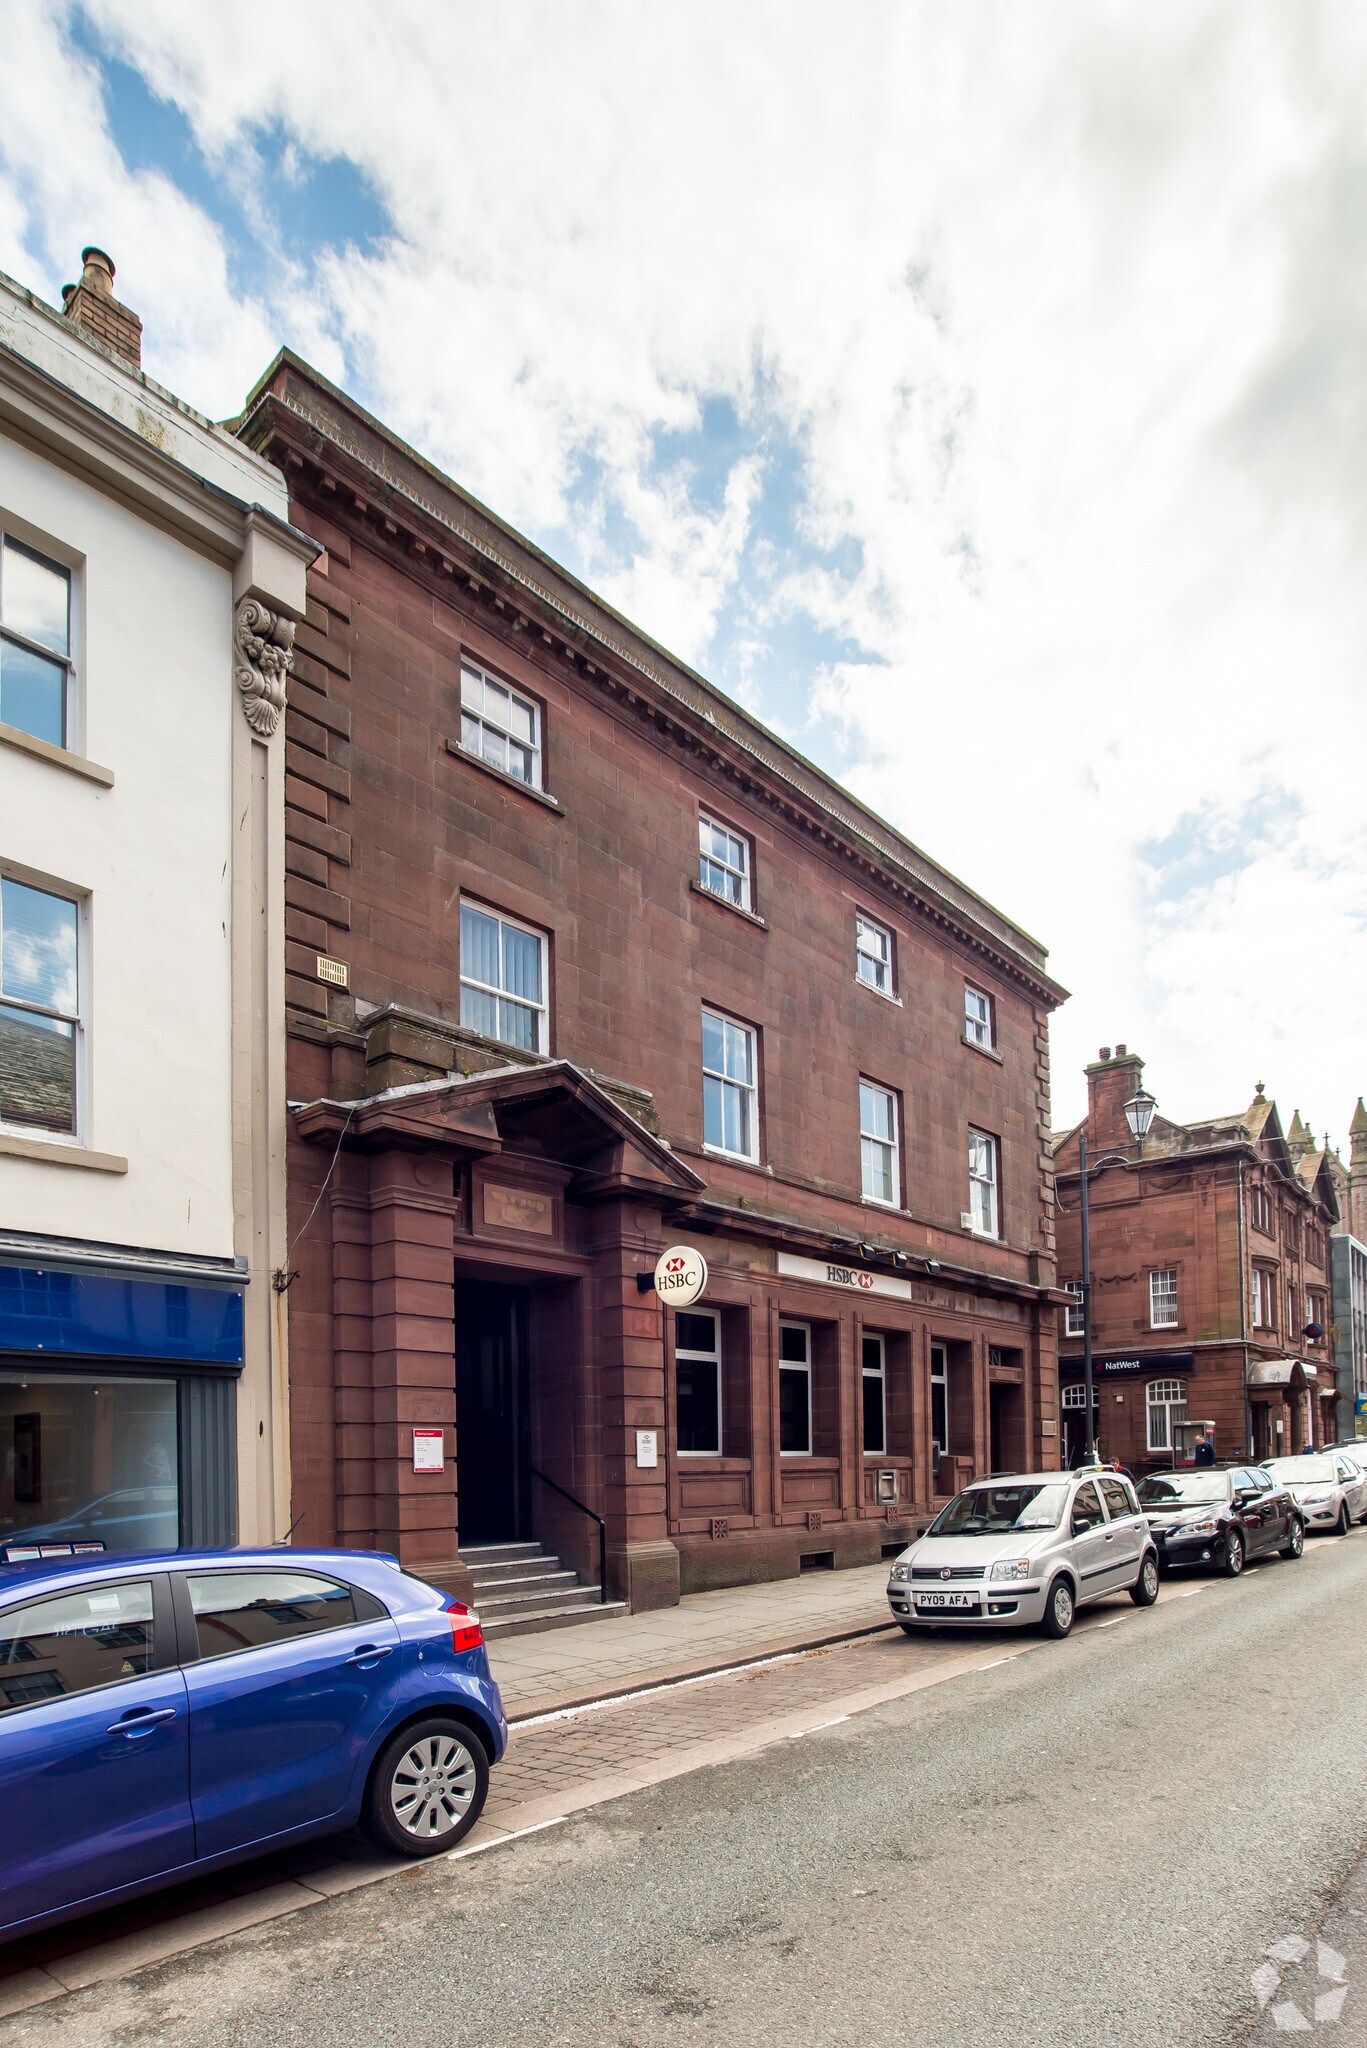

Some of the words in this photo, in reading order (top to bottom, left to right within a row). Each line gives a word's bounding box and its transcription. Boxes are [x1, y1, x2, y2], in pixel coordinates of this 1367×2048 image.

[658, 1271, 697, 1291] HSBC
[827, 1265, 858, 1286] HSBC
[1105, 1360, 1141, 1371] NatWest
[920, 1595, 945, 1606] PY09
[949, 1595, 969, 1606] AFA
